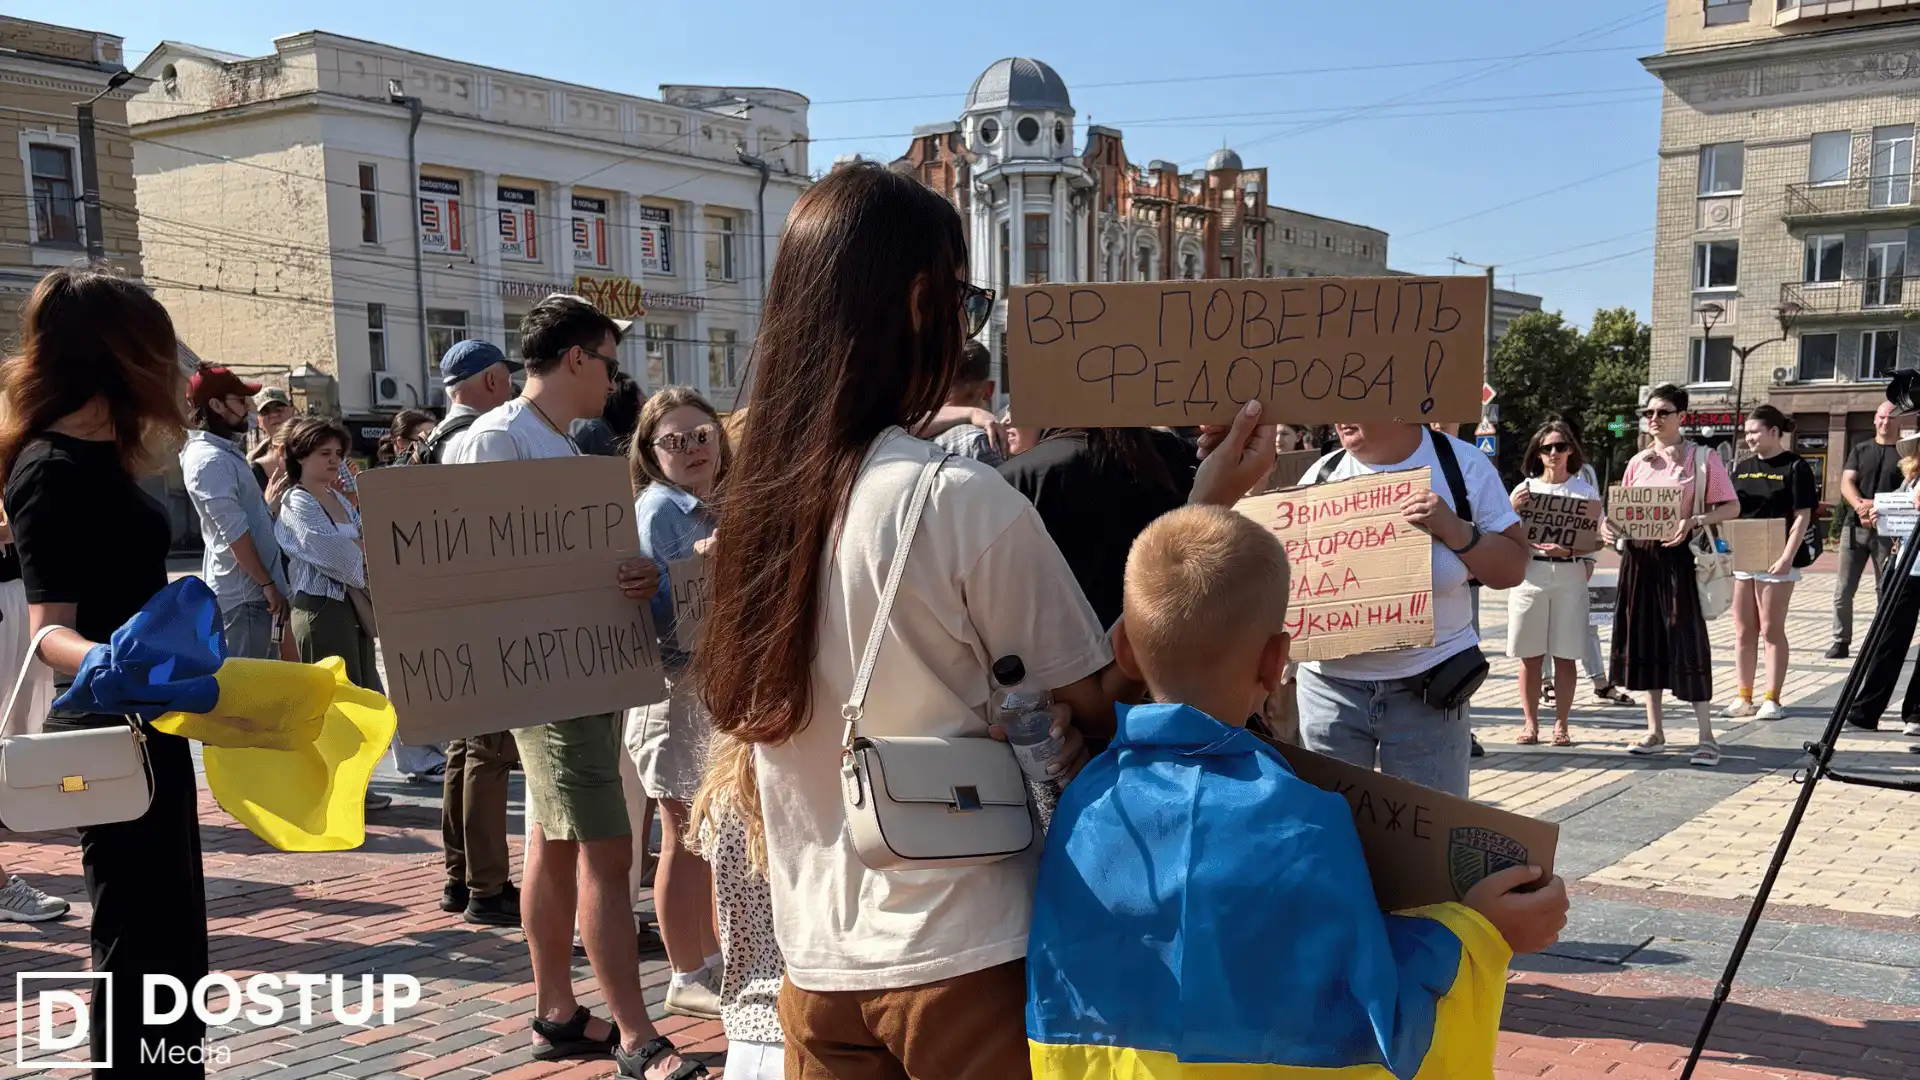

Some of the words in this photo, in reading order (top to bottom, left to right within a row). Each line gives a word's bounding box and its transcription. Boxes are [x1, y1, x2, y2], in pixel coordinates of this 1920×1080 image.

[1023, 289, 1107, 345] ВР
[1157, 278, 1462, 350] ПОВЕРНІТЬ
[1524, 493, 1589, 516] МІСЦЕ
[1612, 488, 1651, 504] НАЩО
[1656, 488, 1682, 503] НАМ
[1519, 508, 1599, 533] ФЕДОРОВА
[1615, 506, 1678, 522] СОВКОВА
[391, 508, 469, 566] МІЙ
[488, 502, 624, 557] МІНІСТР
[1540, 527, 1578, 548] МО
[1619, 522, 1675, 539] АРМІЯ?
[1285, 521, 1397, 565] ЕДОРОВА
[399, 643, 477, 706] МОЯ
